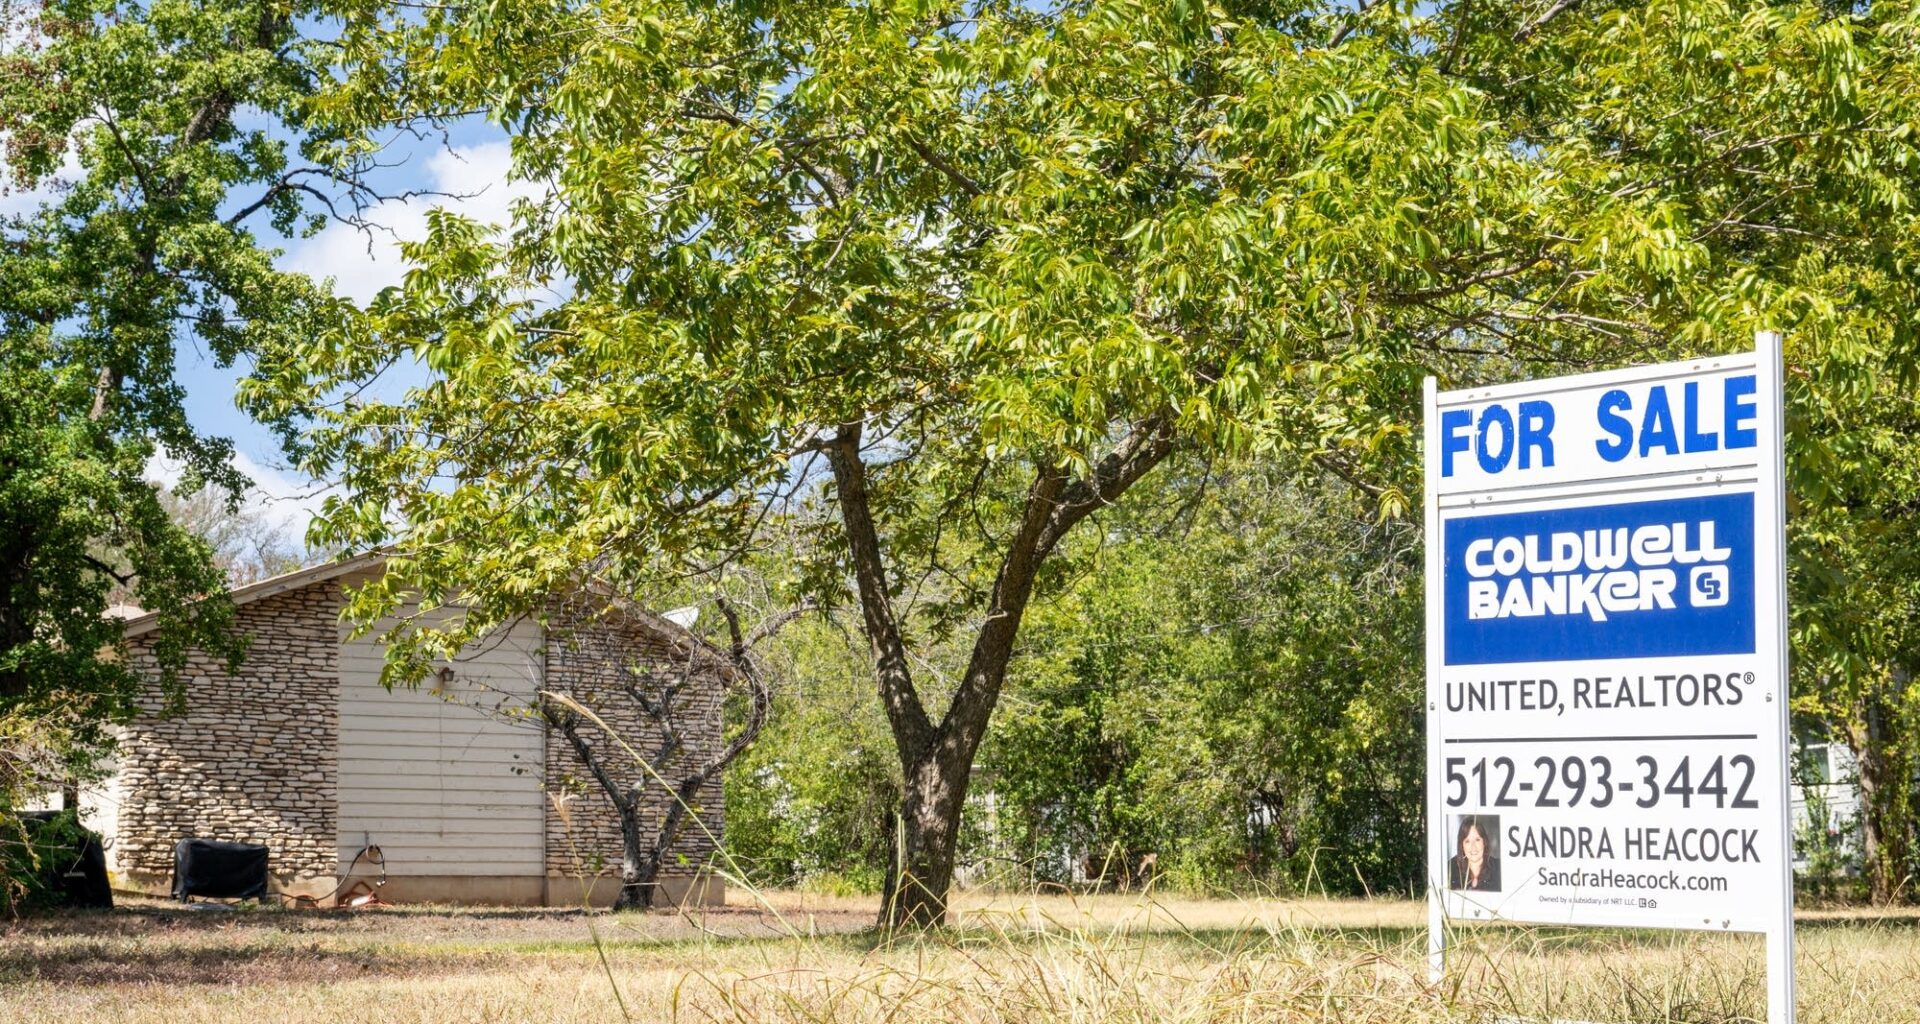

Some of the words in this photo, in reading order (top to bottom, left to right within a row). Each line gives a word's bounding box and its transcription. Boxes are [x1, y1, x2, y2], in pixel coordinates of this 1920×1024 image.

[1441, 400, 1555, 478] FOR
[1595, 374, 1757, 463] SALE
[1446, 679, 1565, 716] UNITED,
[1446, 754, 1759, 809] 512-293-3442
[1508, 825, 1615, 860] SANDRA
[1625, 828, 1761, 863] HEACOCK
[1538, 867, 1728, 892] SandraHeacock.com
